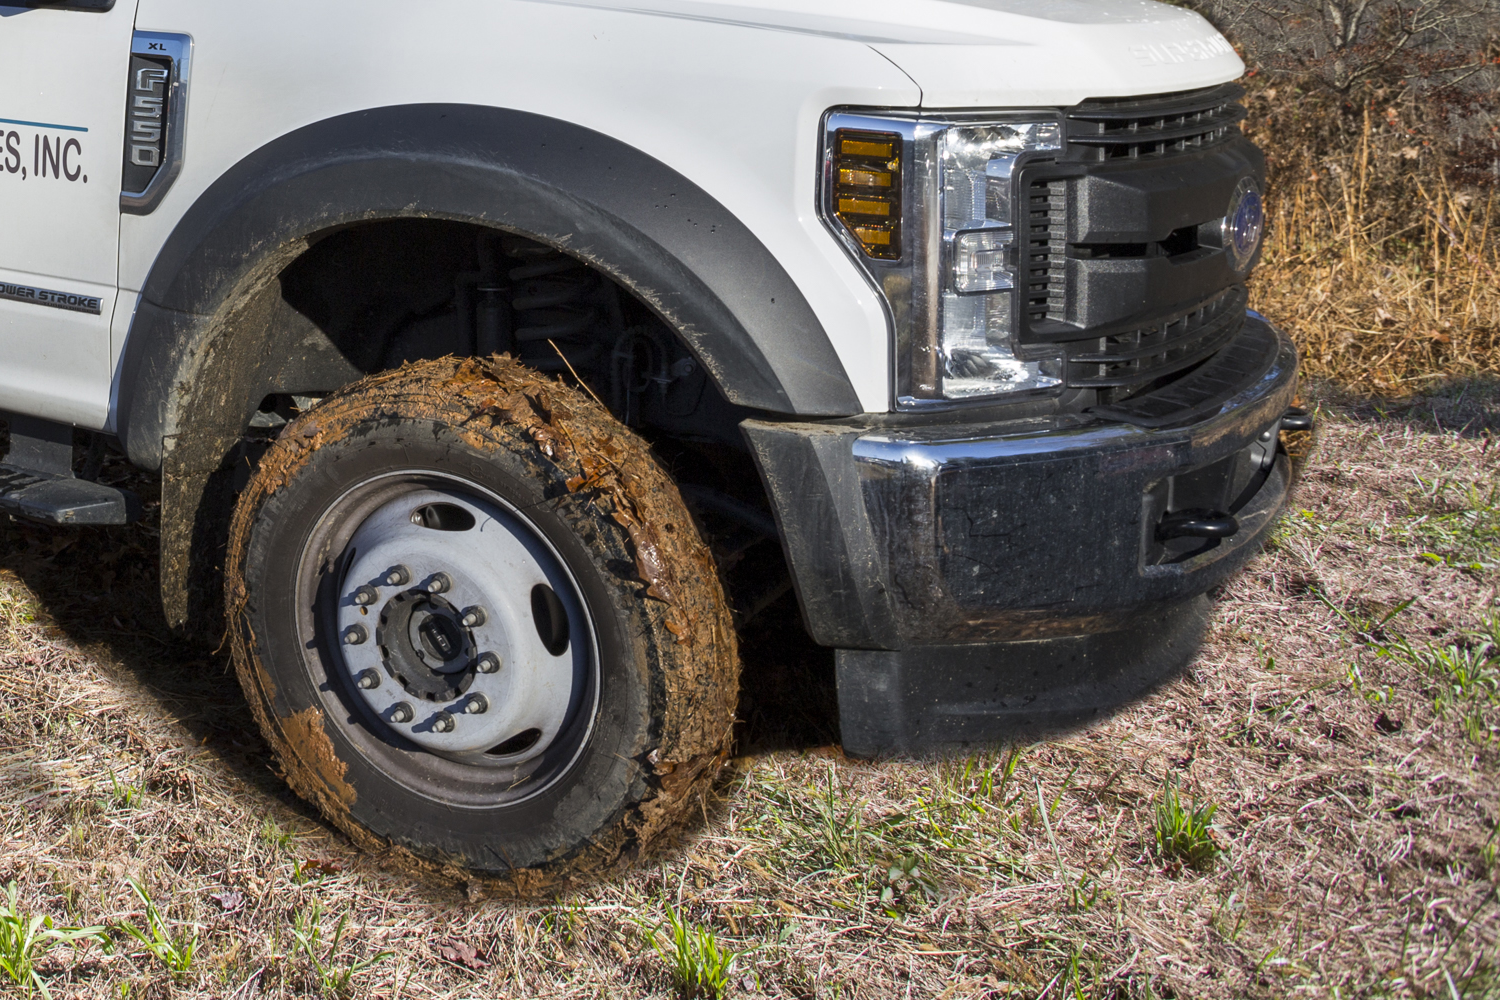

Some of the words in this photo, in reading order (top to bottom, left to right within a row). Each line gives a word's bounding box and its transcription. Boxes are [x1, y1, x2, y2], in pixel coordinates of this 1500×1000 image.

[148, 42, 167, 51] XL
[33, 133, 88, 184] INC.
[38, 290, 98, 309] STROKE
